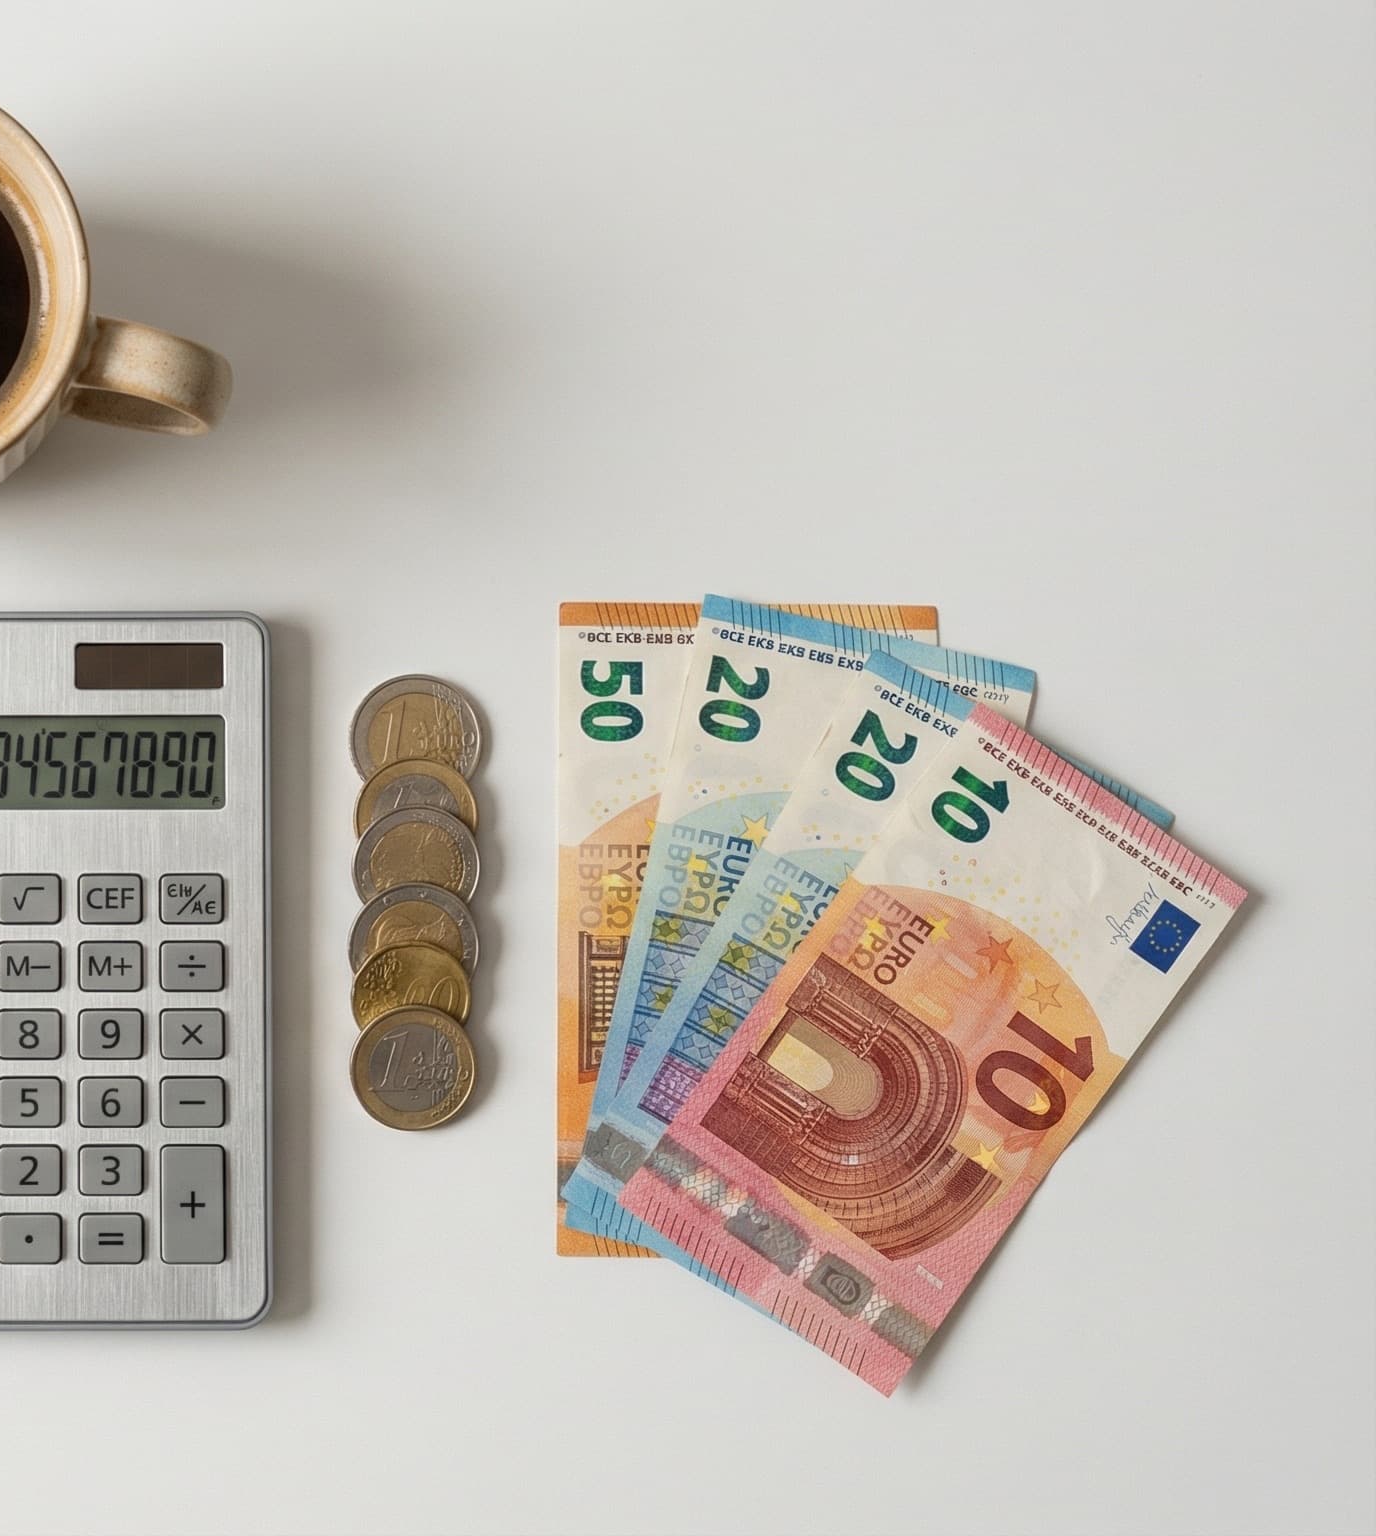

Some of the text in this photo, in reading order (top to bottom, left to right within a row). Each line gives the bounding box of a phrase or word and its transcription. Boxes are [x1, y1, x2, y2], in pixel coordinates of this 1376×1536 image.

[580, 660, 644, 742] 50
[698, 655, 771, 743] 20
[835, 709, 919, 802] 20
[930, 766, 1010, 844] 10
[86, 887, 135, 909] CEF
[873, 915, 936, 985] EURO
[88, 956, 133, 977] M+
[18, 1020, 40, 1049] 8
[100, 1020, 121, 1049] 9
[975, 1011, 1095, 1131] 10
[20, 1088, 39, 1117] 5
[100, 1088, 121, 1117] 6
[19, 1156, 39, 1186] 2
[100, 1156, 121, 1186] 3
